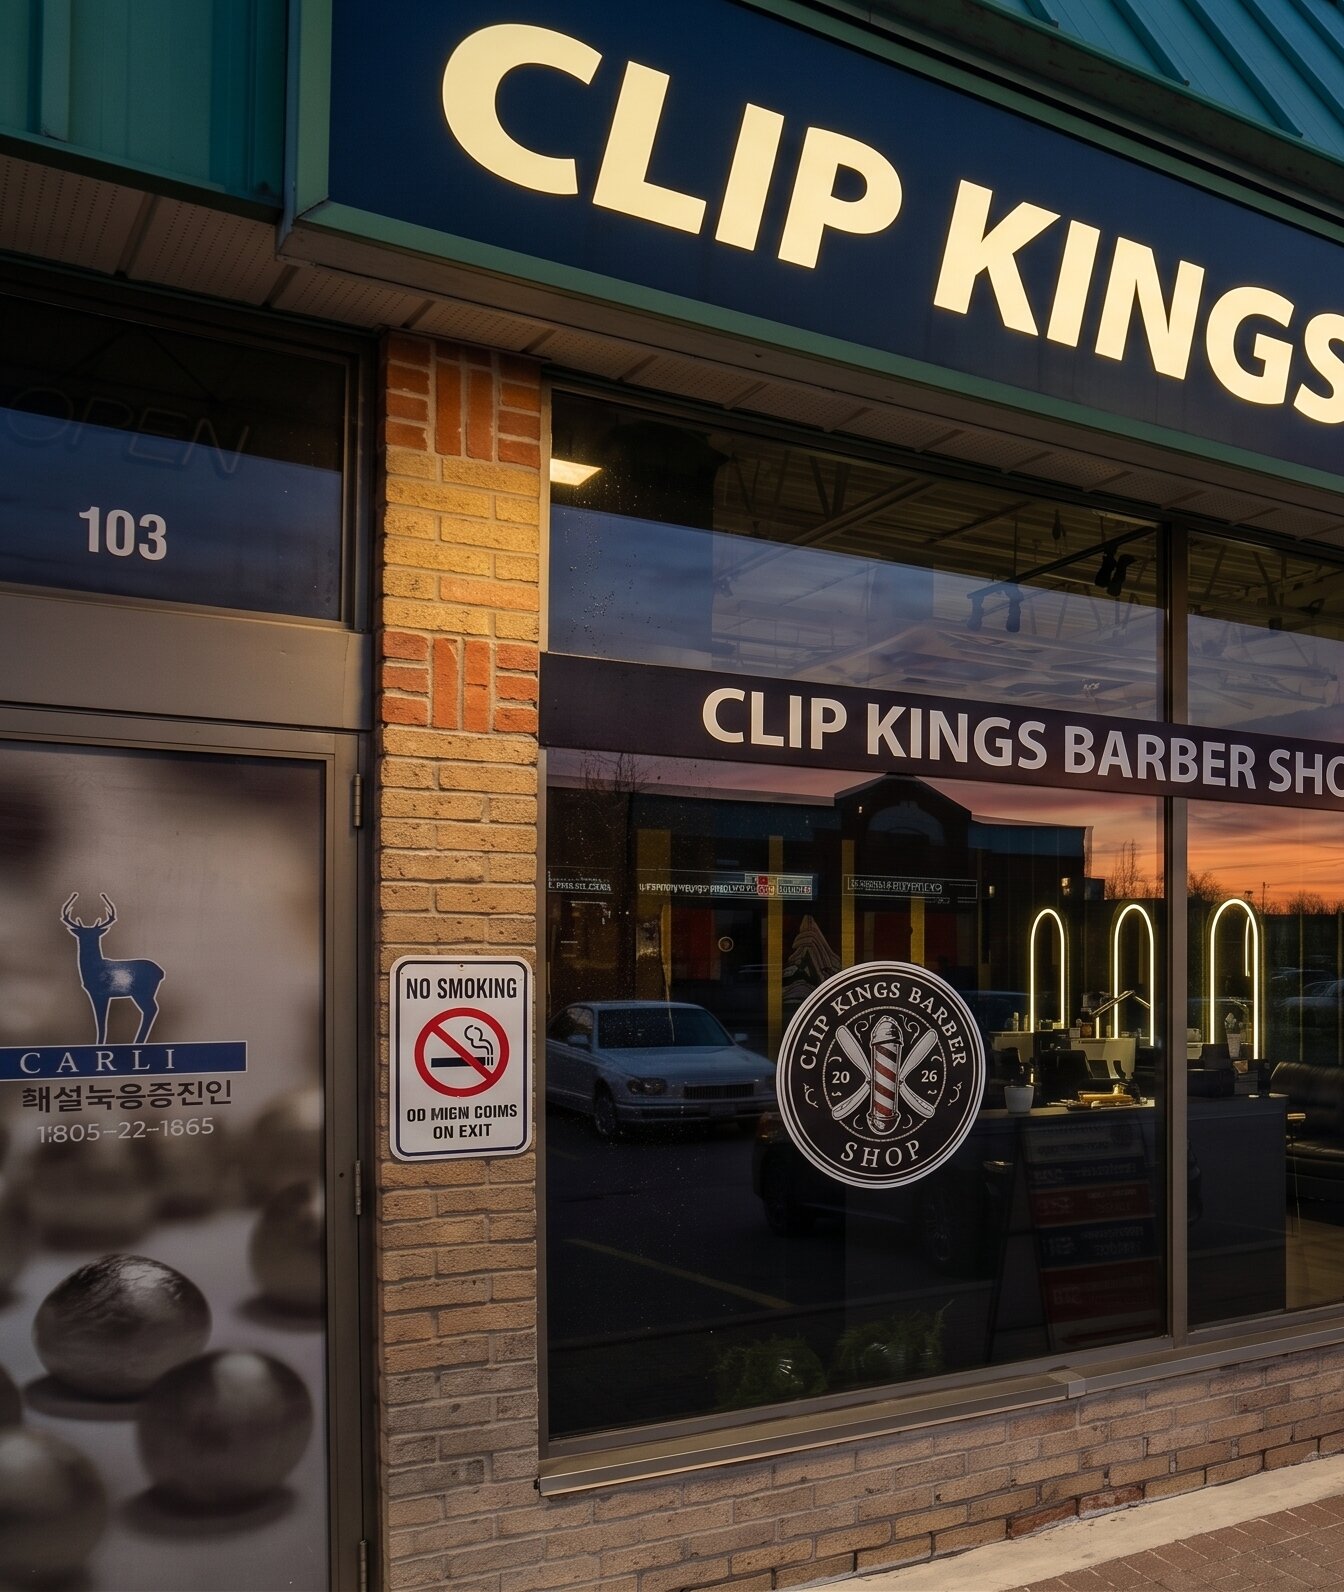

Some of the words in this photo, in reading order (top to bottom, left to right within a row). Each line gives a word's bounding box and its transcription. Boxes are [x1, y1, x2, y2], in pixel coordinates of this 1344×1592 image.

[442, 23, 903, 269] CLIP
[8, 387, 250, 475] OPEN
[79, 506, 167, 560] 103
[702, 688, 847, 750] CLIP
[866, 703, 1048, 770] KINGS
[1064, 725, 1256, 789] BARBER
[406, 978, 430, 999] NO
[437, 978, 517, 999] SMOKING
[800, 1015, 831, 1070] CLIP
[830, 982, 901, 1017] KINGS
[908, 987, 967, 1067] BARBER
[20, 1049, 175, 1074] CARLI
[832, 1071, 850, 1084] 20
[921, 1070, 938, 1082] 26
[433, 1125, 454, 1139] ON
[459, 1123, 492, 1138] EXIT
[840, 1139, 922, 1168] SHOP
